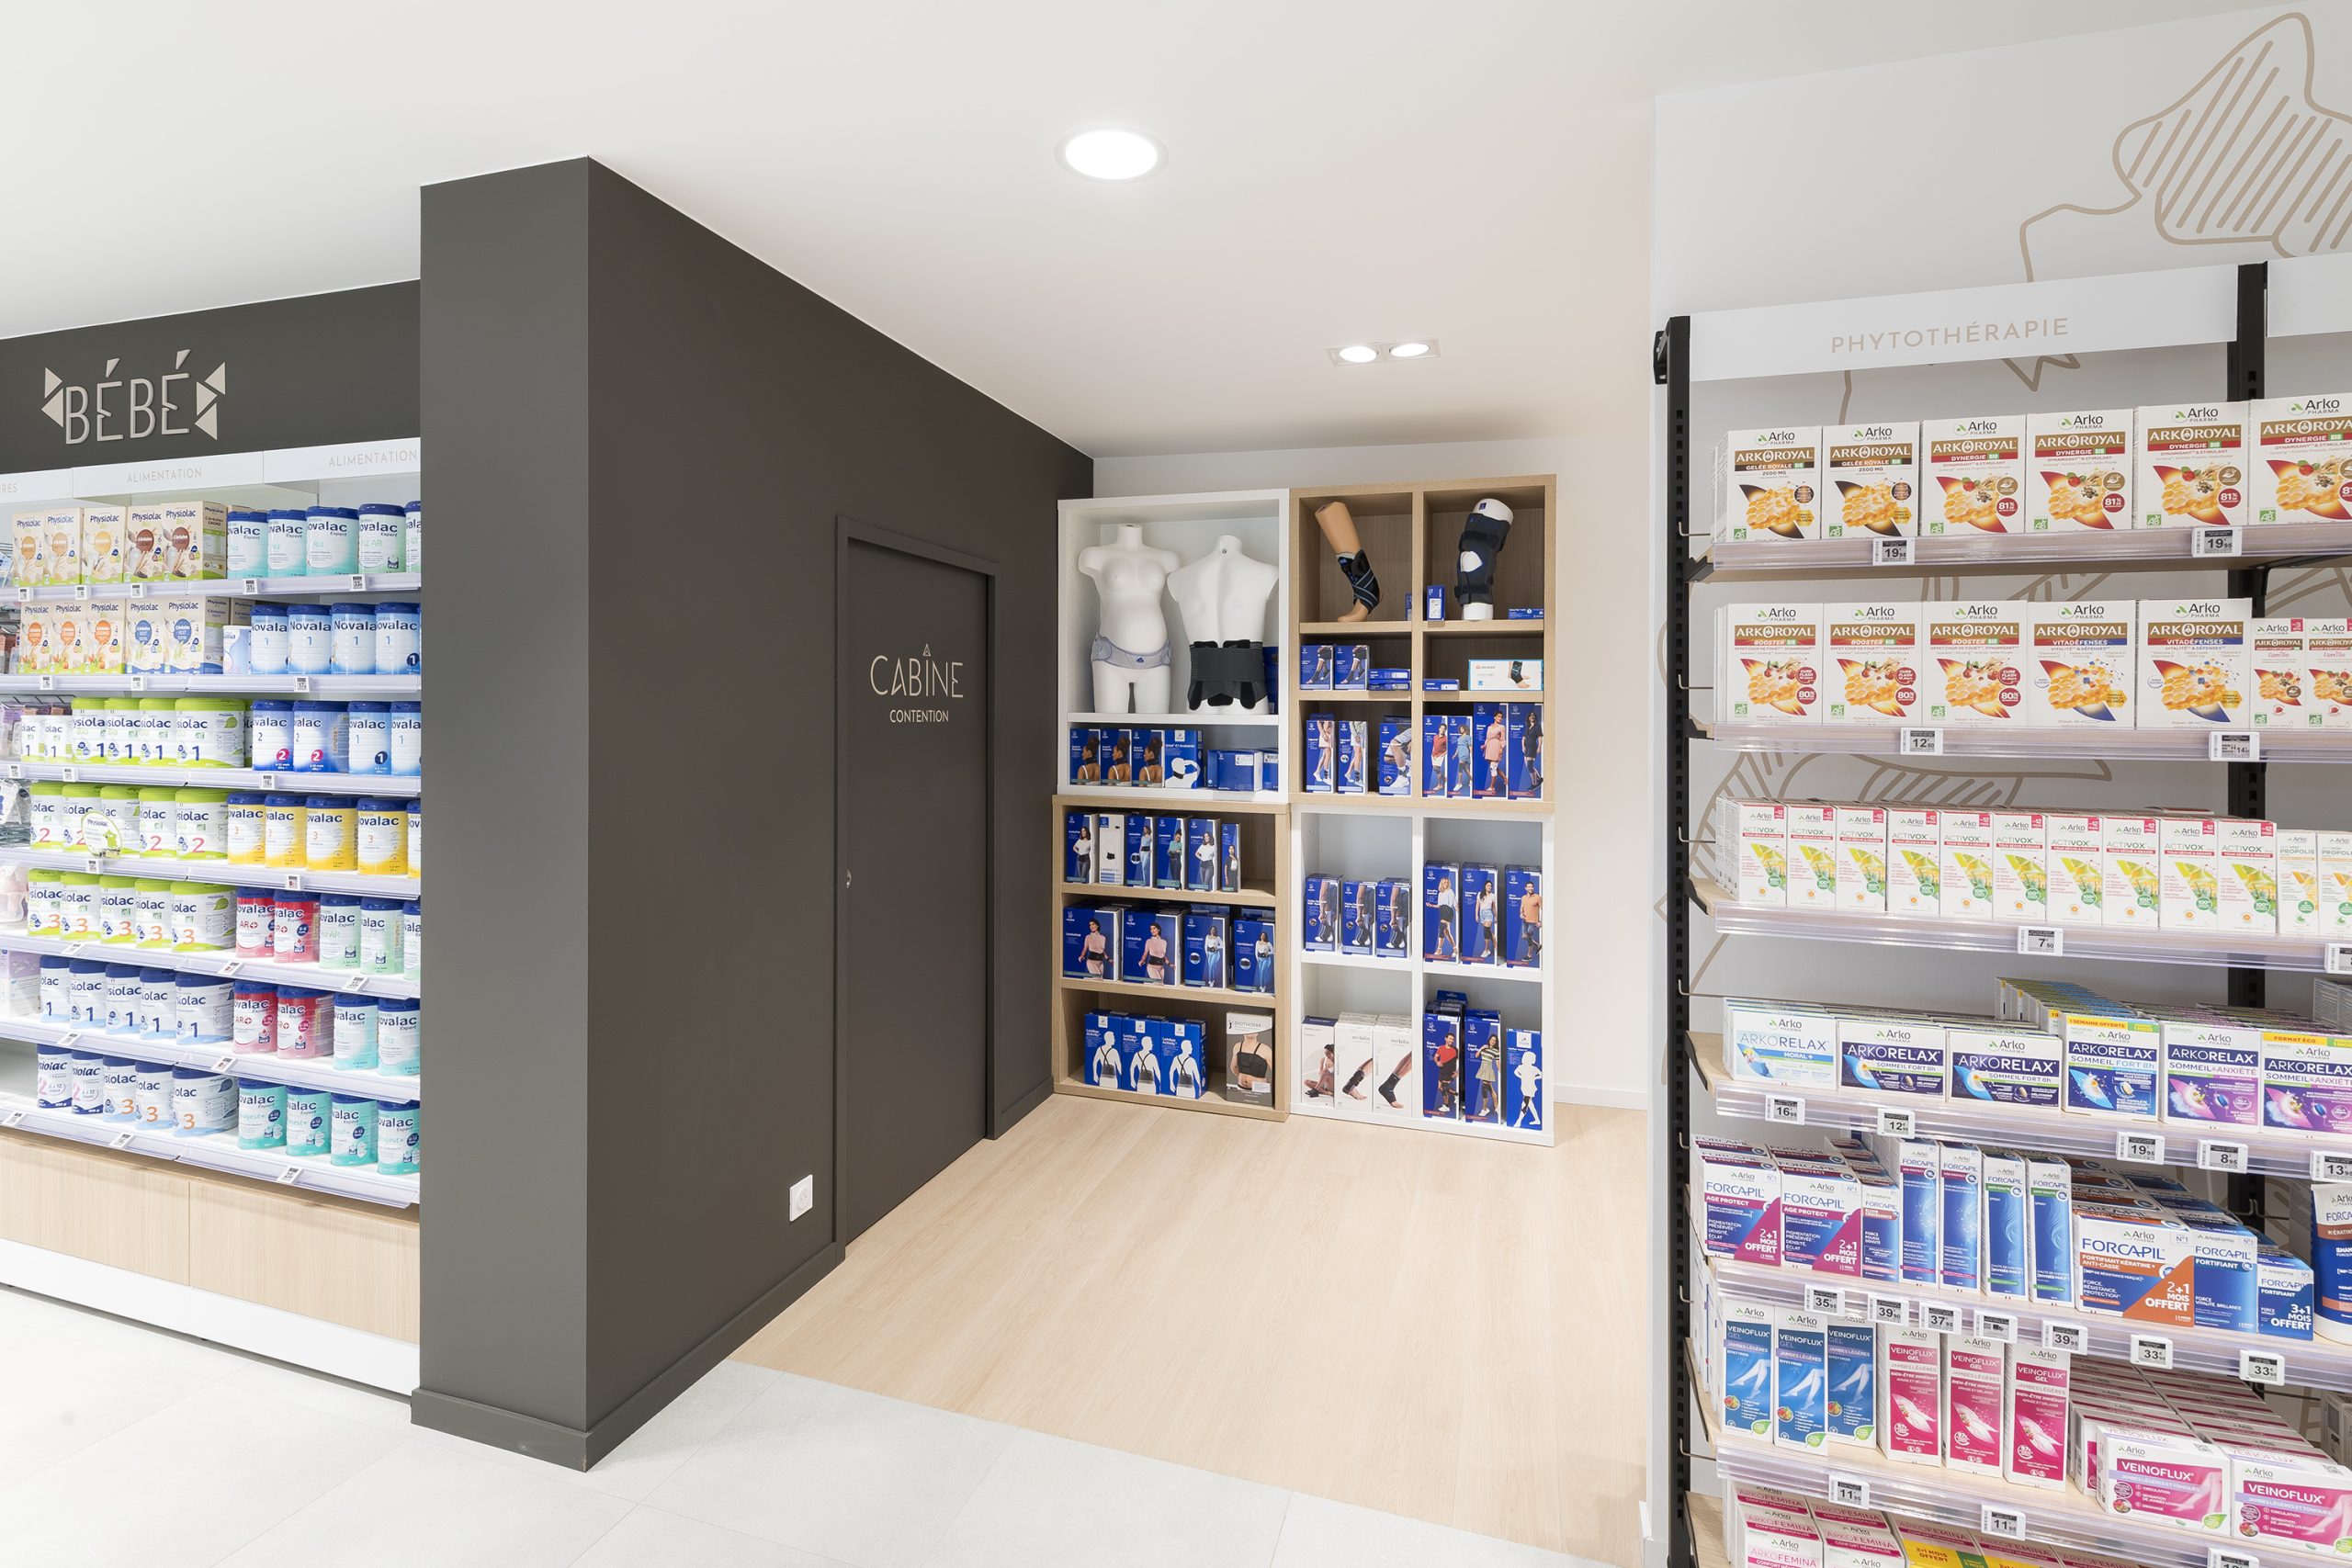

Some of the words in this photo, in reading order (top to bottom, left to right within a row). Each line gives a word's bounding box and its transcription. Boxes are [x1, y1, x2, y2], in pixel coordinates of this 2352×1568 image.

[1831, 318, 2068, 354] PHYTOTHÉRAPIE
[65, 349, 190, 444] BÉBÉ
[2305, 399, 2340, 411] Arko
[2074, 414, 2103, 424] Arko
[2188, 408, 2218, 418] Arko
[1866, 427, 1892, 437] Arko
[1968, 421, 1996, 431] Arko
[1769, 431, 1794, 442] Arko
[2150, 428, 2239, 441] ARKOROYAL
[1933, 440, 2016, 453] ARKOROYAL
[2037, 435, 2123, 447] ARKOROYAL
[328, 449, 417, 467] ALIMENTATION
[1736, 449, 1813, 462] ARKOROYAL
[1832, 446, 1910, 458] ARKOROYAL
[127, 468, 202, 483] ALIMENTATION
[0, 483, 18, 493] RES
[48, 515, 74, 525] Physiolac
[90, 514, 119, 524] Physiolac
[132, 513, 161, 521] Physiolac
[165, 510, 196, 519] Physiolac
[17, 520, 41, 529] Physiolac
[25, 606, 49, 615] Physiolac
[56, 605, 81, 614] Physiolac
[92, 604, 119, 613] Physiolac
[130, 604, 158, 612] Physiolac
[169, 602, 198, 611] Physiolac
[1769, 608, 1796, 617] Arko
[1867, 607, 1894, 616] Arko
[1968, 605, 1997, 615] Arko
[2074, 604, 2104, 615] Arko
[2188, 604, 2220, 614] Arko
[1736, 626, 1814, 637] ARKOROYAL
[1832, 626, 1912, 637] ARKOROYAL
[1932, 625, 2017, 637] ARKOROYAL
[2036, 625, 2125, 637] ARKOROYAL
[2150, 623, 2241, 637] ARKOROYAL
[410, 654, 416, 664] 1
[870, 655, 964, 698] CABINE
[889, 709, 949, 723] CONTENTION
[96, 743, 105, 758] 1
[125, 744, 133, 759] 1
[156, 745, 163, 760] 1
[193, 746, 199, 761] 1
[278, 750, 287, 761] 2
[312, 751, 321, 761] 2
[378, 753, 385, 763] 1
[40, 829, 51, 842] 2
[151, 836, 162, 851] 2
[192, 838, 205, 852] 2
[76, 919, 88, 932] 3
[119, 921, 131, 936] 3
[151, 926, 163, 941] 3
[1779, 1019, 1802, 1029] Arko
[1886, 1030, 1910, 1039] Arko
[2208, 1033, 2232, 1043] Arko
[1740, 1032, 1826, 1051] ARKORELAX
[2000, 1040, 2025, 1050] Arko
[1849, 1044, 1938, 1063] ARKORELAX
[2073, 1043, 2152, 1060] ARKORELAX
[2171, 1048, 2254, 1064] ARKORELAX
[1959, 1055, 2053, 1073] ARKORELAX
[2071, 1055, 2114, 1066] SOMMEIL
[121, 1099, 133, 1114] 3
[147, 1107, 159, 1122] 3
[184, 1114, 195, 1129] 3
[1707, 1181, 1762, 1198] FORCAPIL
[1718, 1198, 1749, 1206] PROTECT
[1784, 1193, 1843, 1209] FORCAPIL
[1796, 1209, 1828, 1217] PROTECT
[1760, 1228, 1777, 1239] 2+1
[1745, 1243, 1777, 1254] OFFERT
[2083, 1238, 2165, 1260] FORCAPIL
[2196, 1246, 2249, 1259] FORCAPIL
[1824, 1254, 1856, 1265] OFFERT
[2083, 1254, 2120, 1263] FORTIFIANT
[2196, 1259, 2238, 1269] FORTIFIANT
[2083, 1260, 2120, 1270] ANTI-CASSE
[2167, 1281, 2189, 1294] 2+1
[2145, 1298, 2189, 1311] OFFERT
[2291, 1304, 2311, 1315] 3+1
[2270, 1317, 2312, 1330] OFFERT
[1727, 1325, 1768, 1337] VEINOFLUX
[1780, 1334, 1821, 1346] VEINOFLUX
[1891, 1347, 1933, 1357] VEINOFLUX
[2018, 1367, 2063, 1378] VEINOFLUX
[2121, 1461, 2190, 1481] VEINOFLUX
[2248, 1483, 2321, 1505] VEINOFLUX
[1751, 1548, 1816, 1567] ARKOFEMINA
